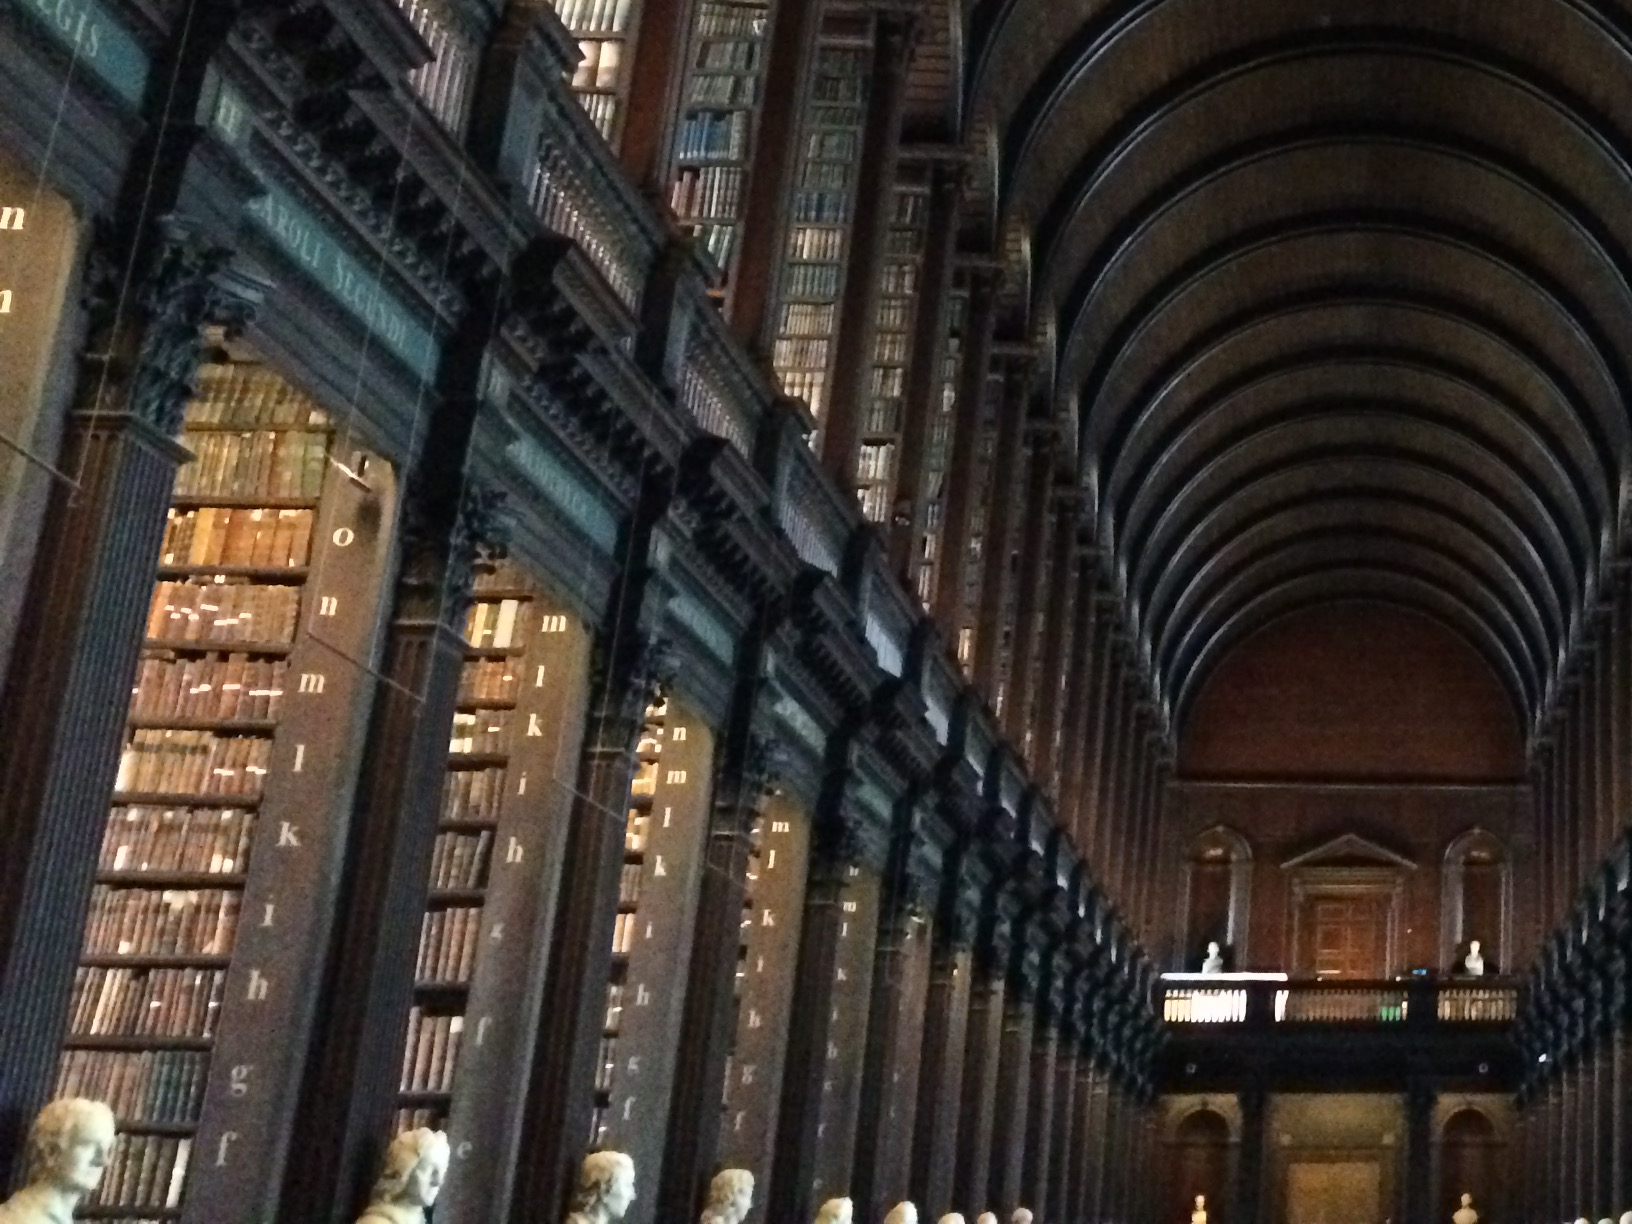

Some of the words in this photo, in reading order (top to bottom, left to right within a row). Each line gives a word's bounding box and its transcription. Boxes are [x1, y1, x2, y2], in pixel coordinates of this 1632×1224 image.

[256, 193, 323, 268] AROLI
[332, 527, 355, 547] o
[319, 596, 338, 617] n
[541, 615, 567, 633] m
[298, 673, 326, 694] m
[526, 713, 543, 737] k
[672, 726, 687, 742] n
[666, 770, 687, 785] m
[277, 821, 300, 847] k
[771, 821, 790, 833] m
[506, 836, 524, 863] h
[654, 854, 667, 877] k
[761, 908, 775, 927] k
[247, 969, 269, 1000] h
[635, 983, 650, 1006] h
[229, 1064, 253, 1096] g
[622, 1096, 636, 1121] f
[215, 1131, 238, 1167] f
